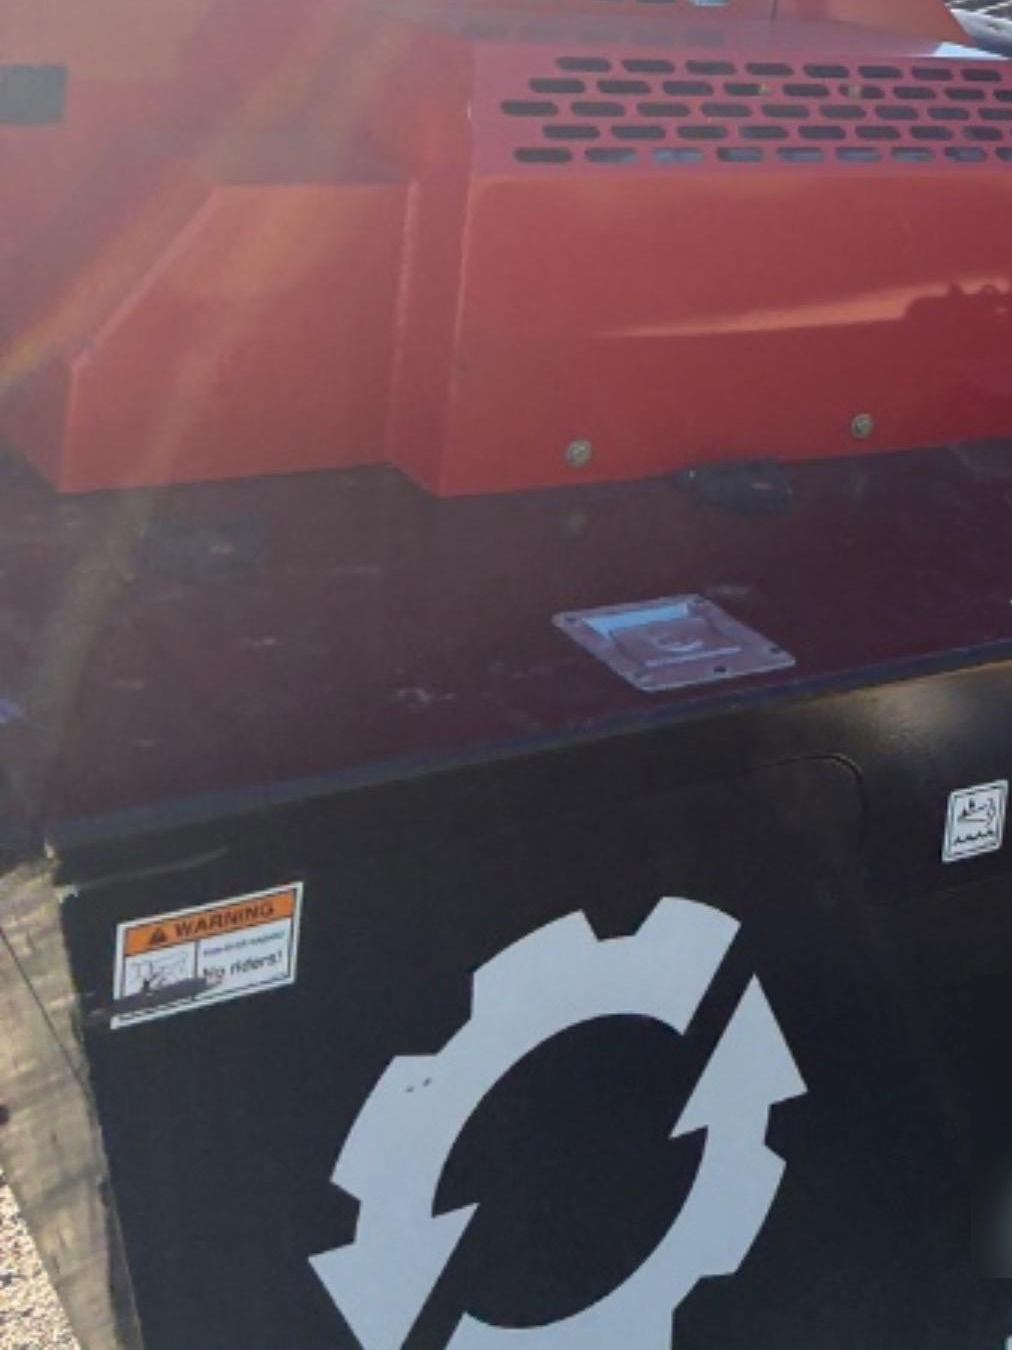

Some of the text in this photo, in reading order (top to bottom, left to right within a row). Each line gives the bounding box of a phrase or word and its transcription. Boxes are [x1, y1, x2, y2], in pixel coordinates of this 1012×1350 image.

[175, 900, 275, 939] WARNING
[203, 948, 282, 982] No riders!
